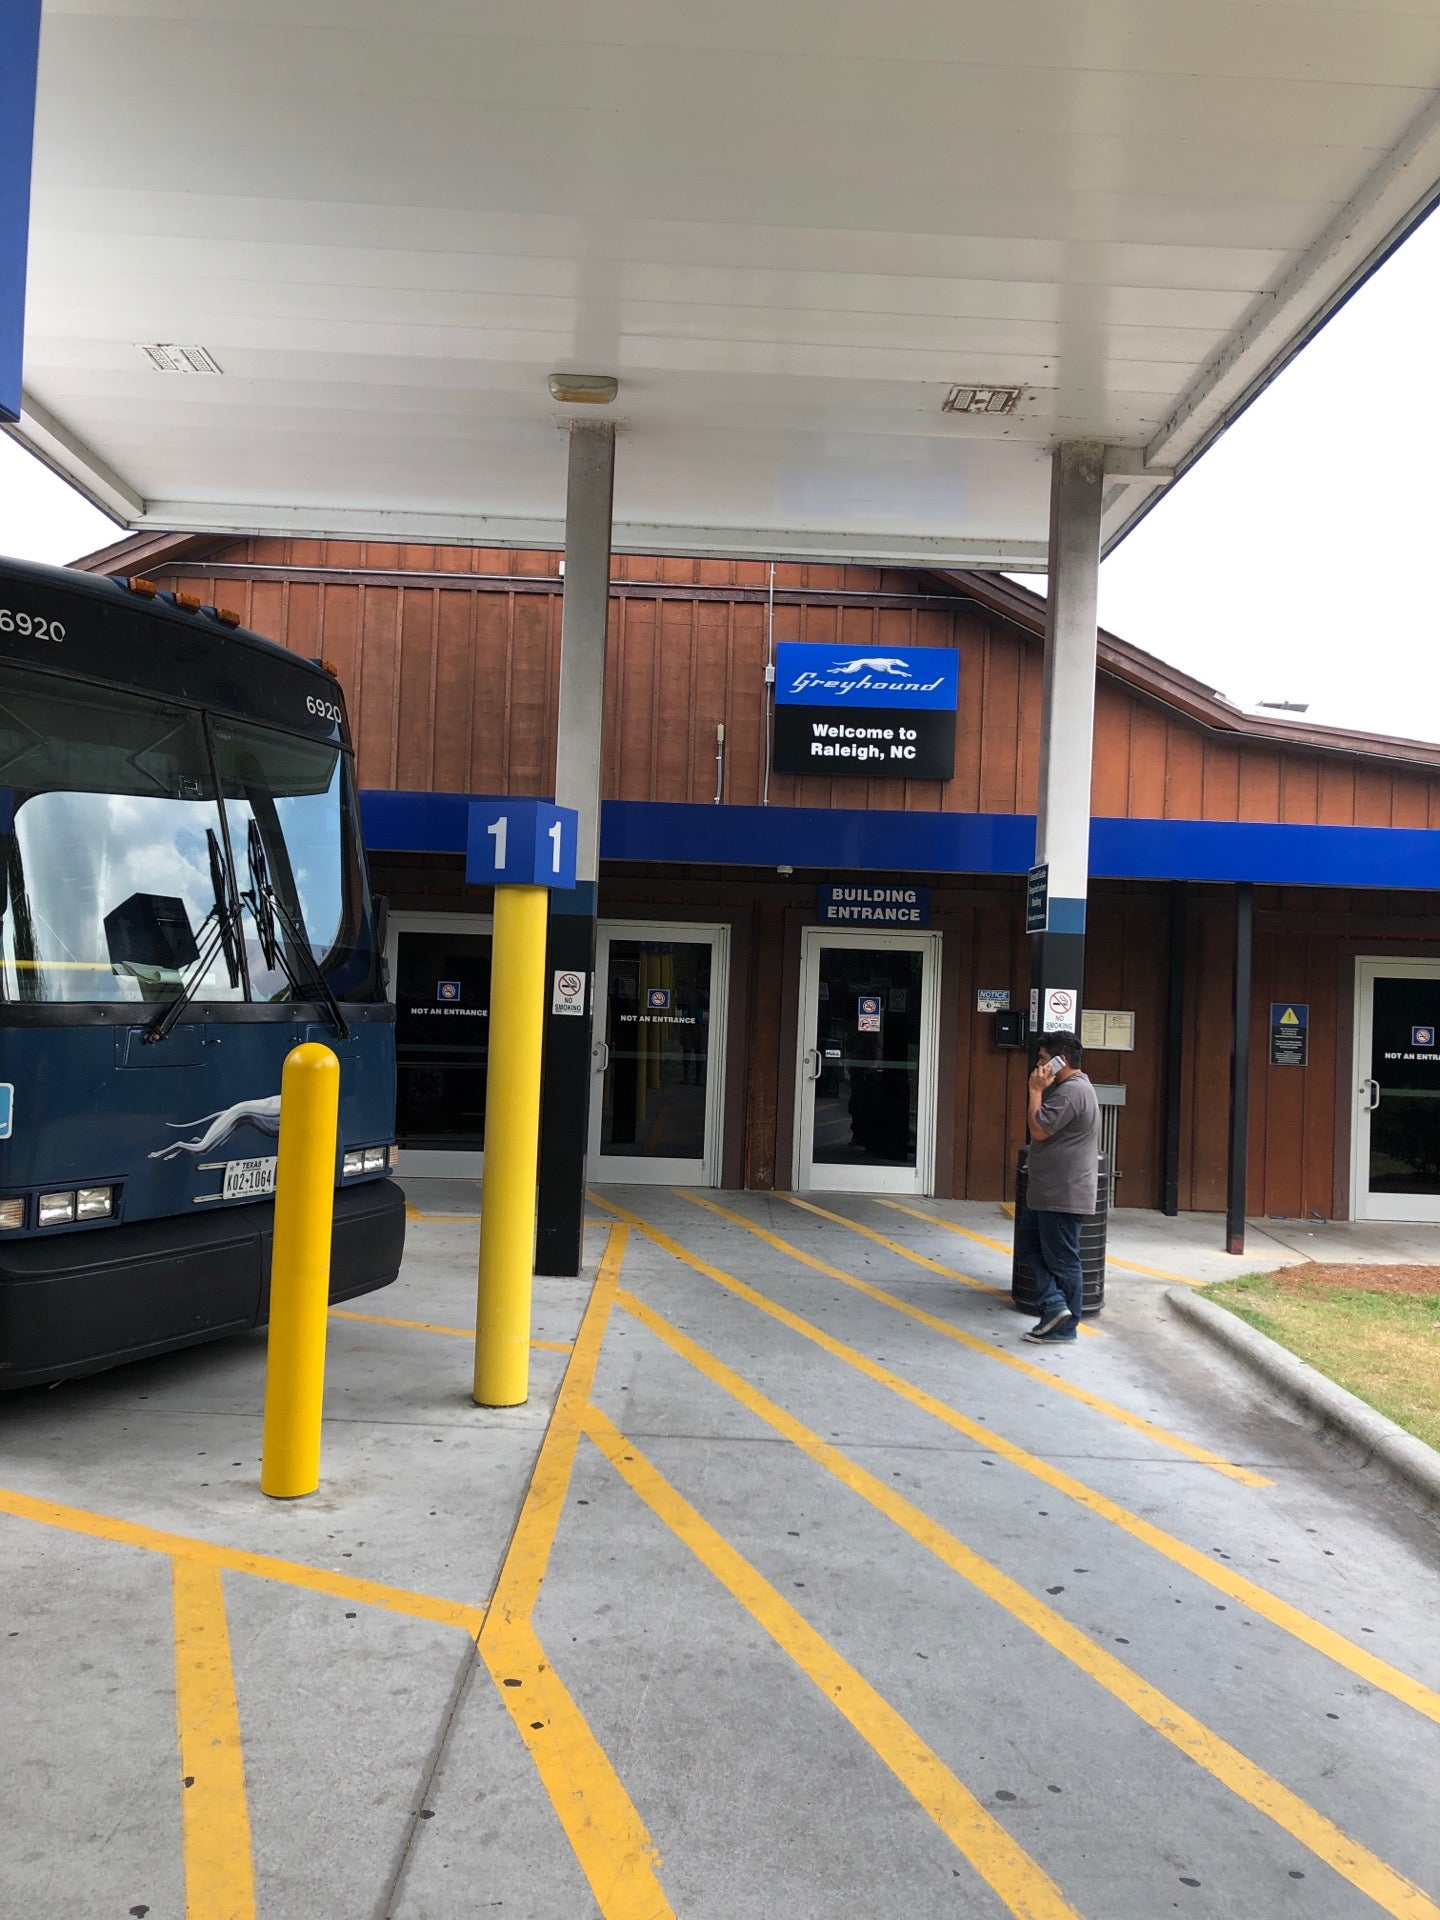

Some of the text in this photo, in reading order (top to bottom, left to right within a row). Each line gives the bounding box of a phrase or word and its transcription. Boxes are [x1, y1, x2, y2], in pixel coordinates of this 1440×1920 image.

[0, 609, 66, 642] 6920
[789, 672, 945, 695] Greyhound
[306, 695, 342, 724] 6920
[812, 723, 917, 741] Welcome to
[810, 742, 917, 760] Raleigh, NC
[487, 816, 508, 869] 1
[548, 821, 562, 873] 1
[832, 888, 917, 903] BUILDING
[827, 906, 921, 921] ENTRANCE
[979, 990, 1008, 998] NOTICE
[410, 1007, 429, 1015] NOT
[443, 1008, 488, 1017] ENTRANCE
[620, 1014, 638, 1022] NOT
[652, 1016, 696, 1024] ENTRANCE
[1384, 1052, 1402, 1060] NOT
[242, 1160, 263, 1169] TEXAS
